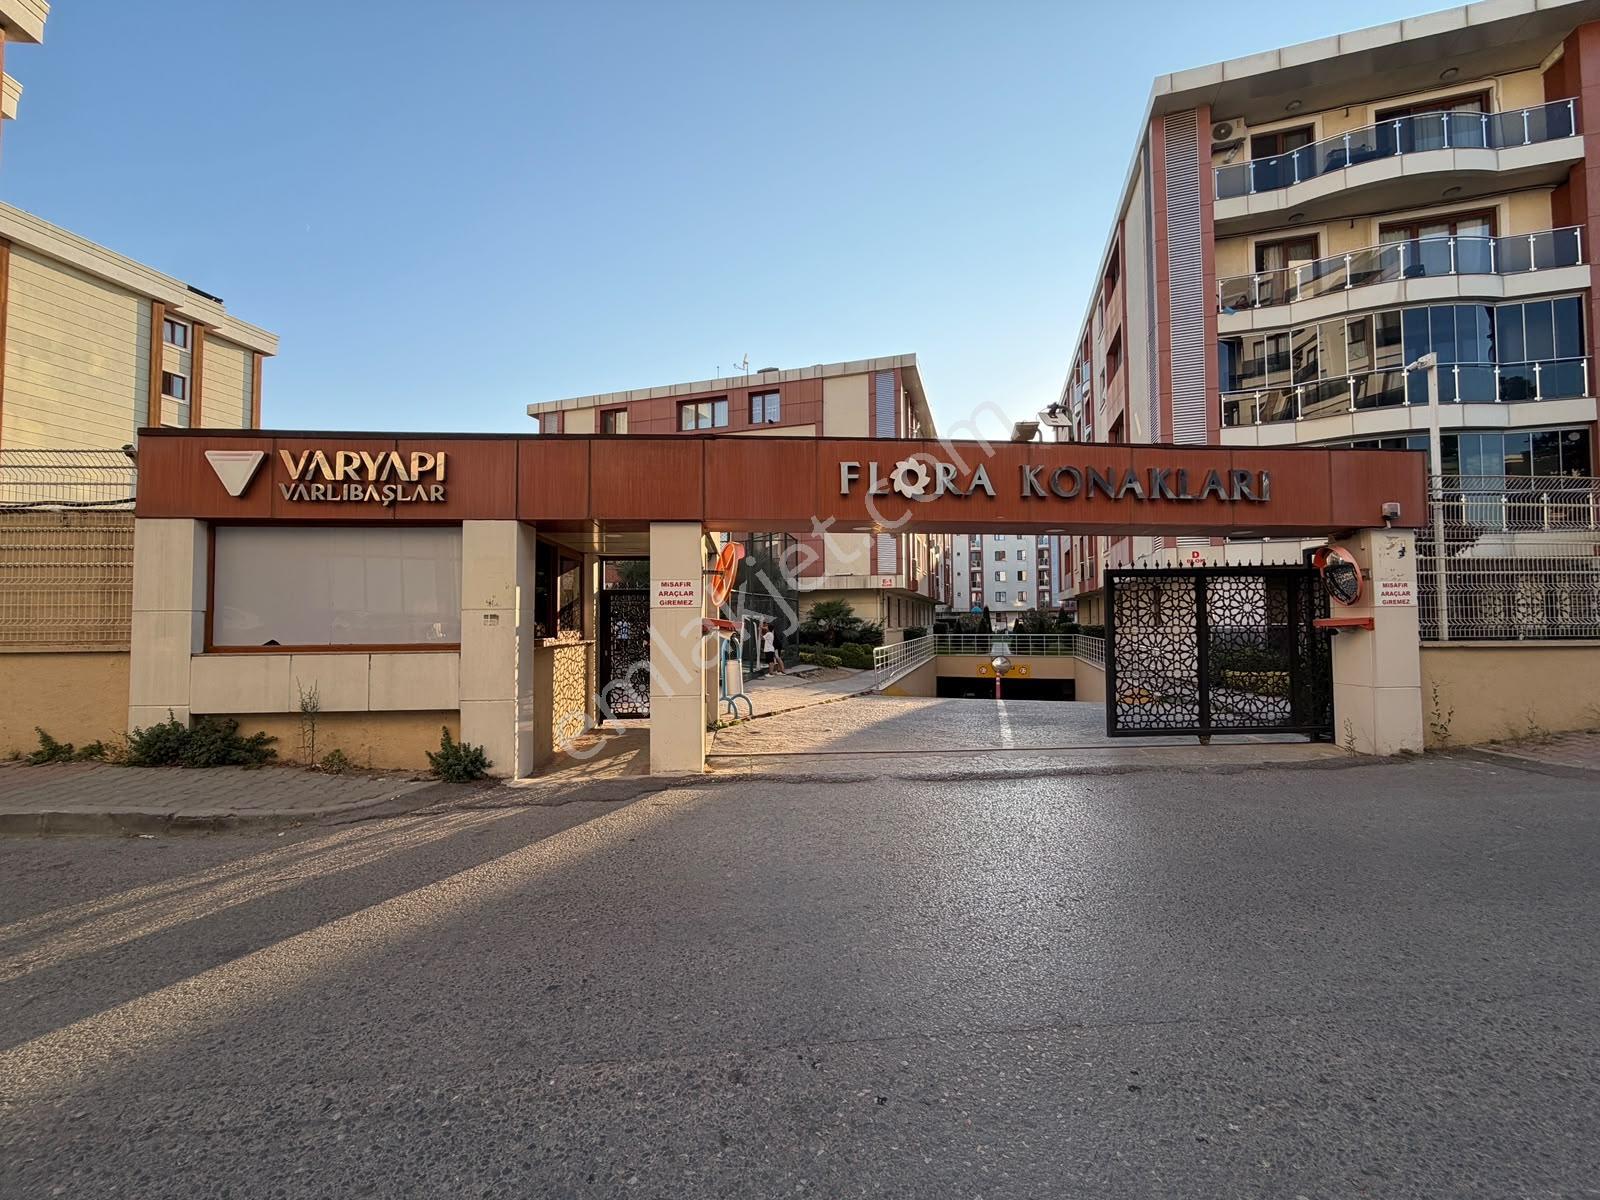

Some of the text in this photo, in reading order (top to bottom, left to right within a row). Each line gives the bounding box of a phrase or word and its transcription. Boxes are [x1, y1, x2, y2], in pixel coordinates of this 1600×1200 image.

[279, 449, 448, 481] VARYAPI
[839, 457, 1271, 502] FLORA KONAKLARI
[278, 482, 447, 506] VARLIBAŞLAR
